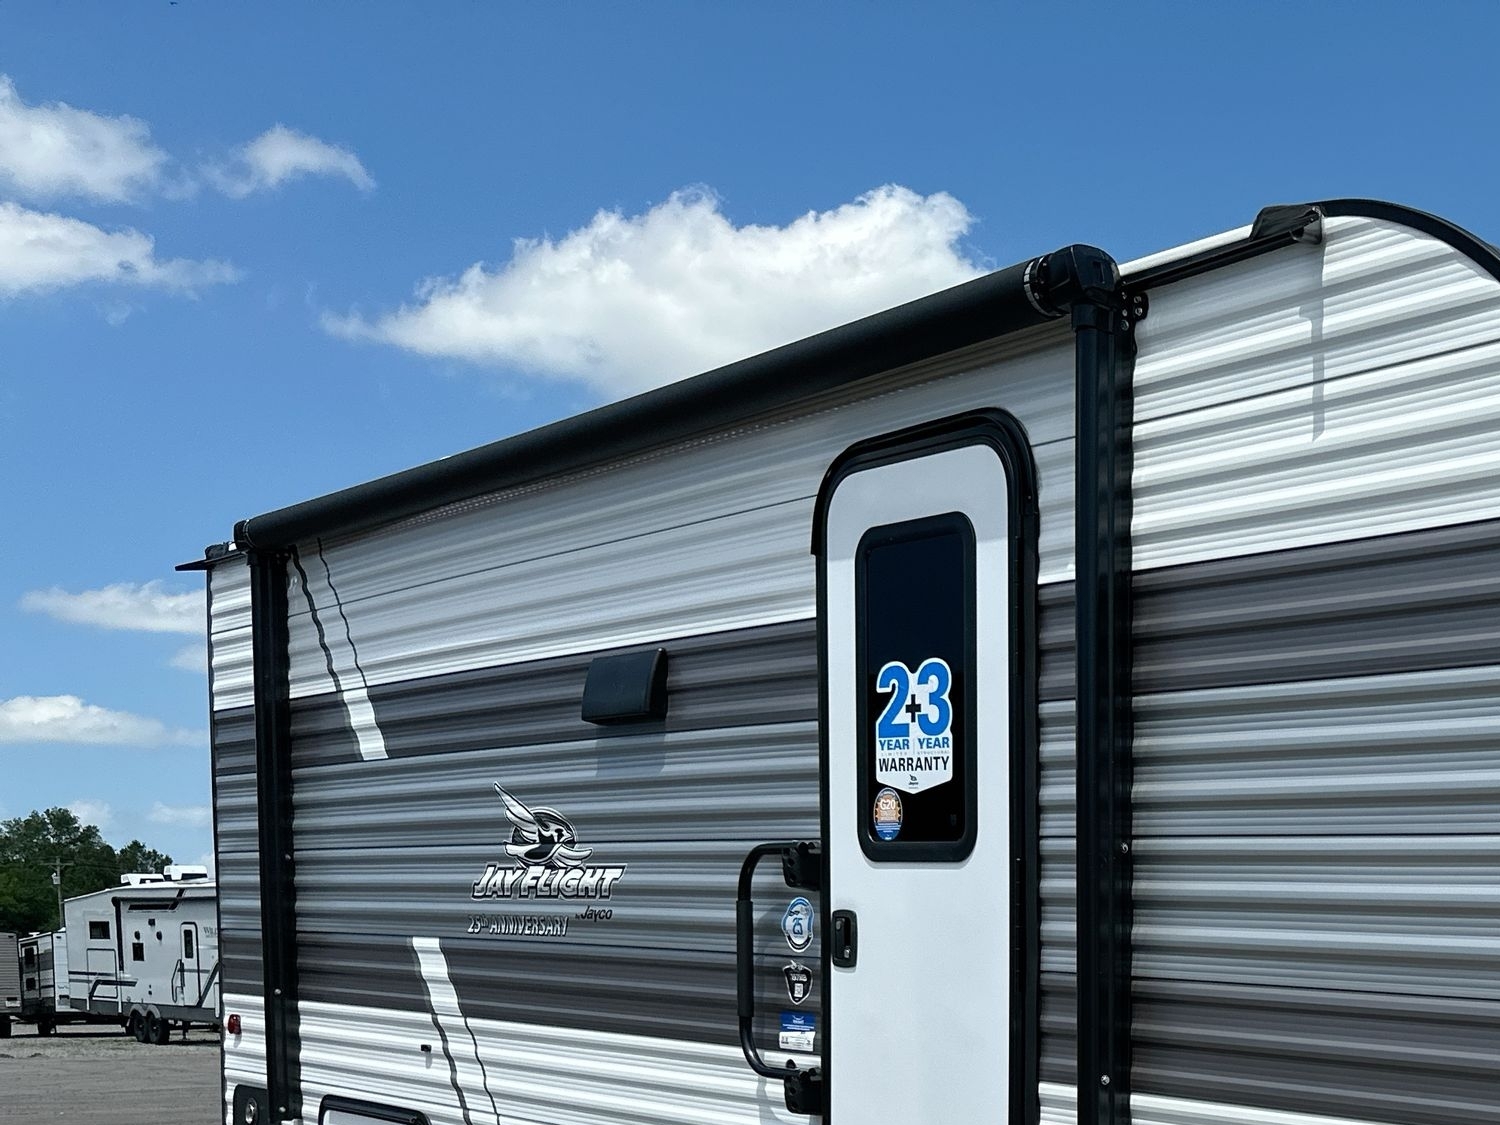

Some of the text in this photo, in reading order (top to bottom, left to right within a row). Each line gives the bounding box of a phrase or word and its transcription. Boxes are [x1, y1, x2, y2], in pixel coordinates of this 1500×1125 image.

[878, 736, 950, 751] YEAR YEAR
[878, 755, 950, 772] WARRANTY
[880, 799, 896, 810] G20
[581, 905, 613, 922] Jayco
[490, 914, 569, 937] ANNIVERSARY
